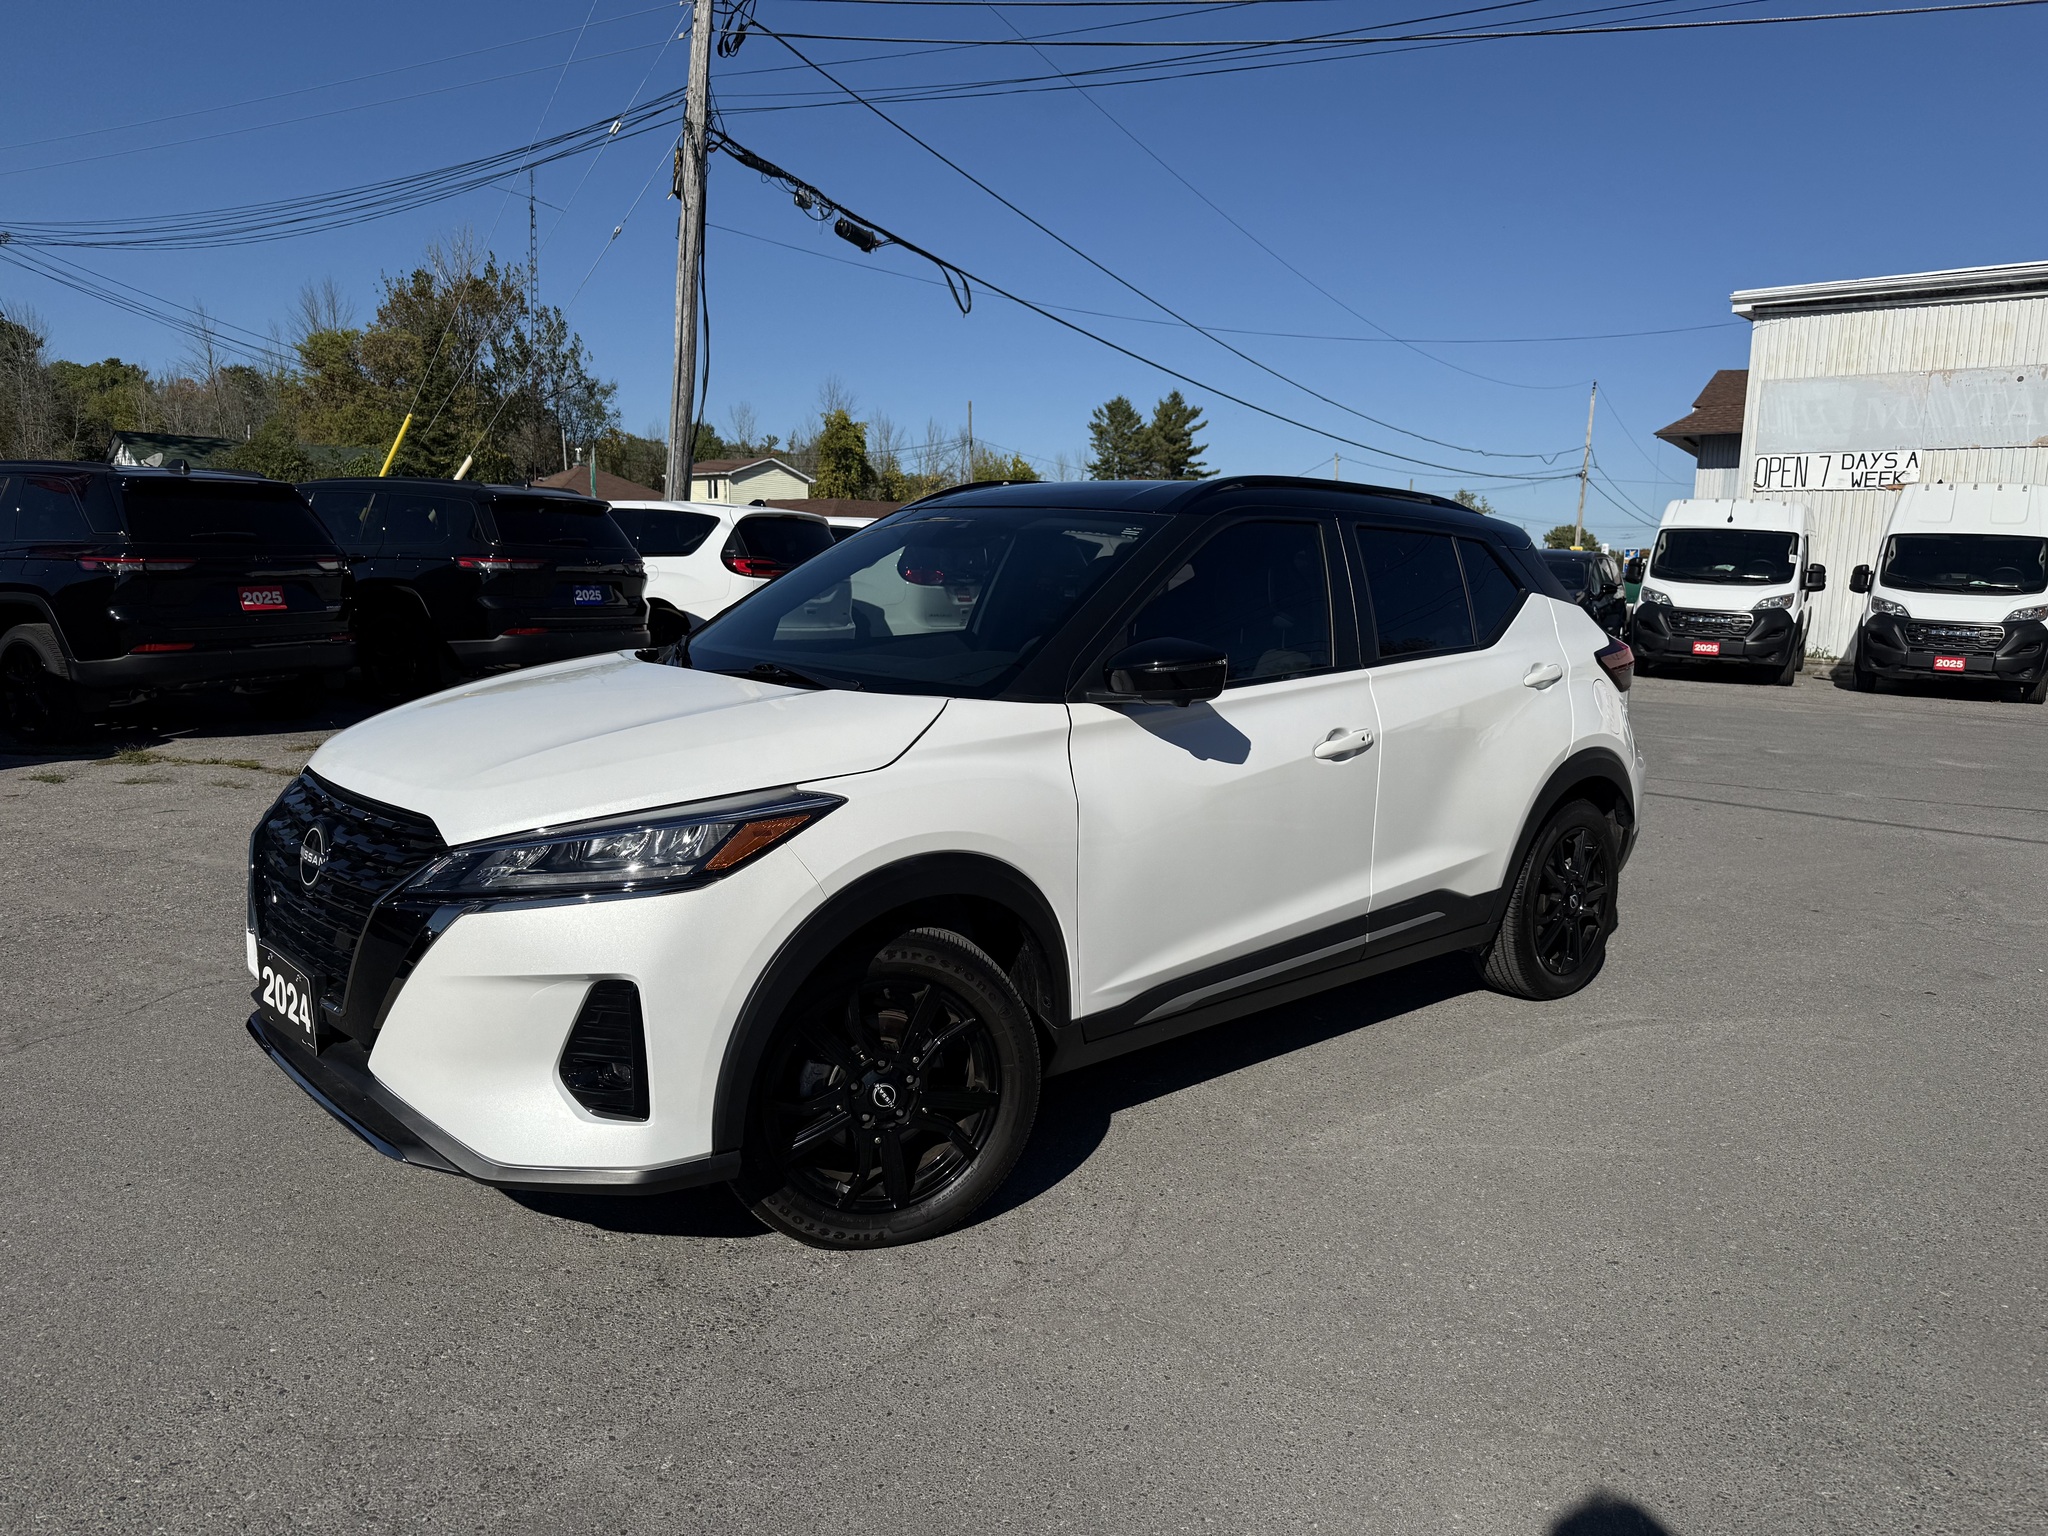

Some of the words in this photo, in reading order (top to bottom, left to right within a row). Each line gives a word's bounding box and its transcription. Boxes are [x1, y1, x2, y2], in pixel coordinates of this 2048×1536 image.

[1754, 456, 1809, 488] OPEN
[1819, 455, 1831, 487] 7
[1841, 452, 1898, 470] DAYS
[1906, 451, 1918, 469] A
[1851, 471, 1906, 488] WEEK
[242, 591, 282, 605] 2025
[575, 589, 602, 601] 2025
[1694, 643, 1719, 653] 2025
[1936, 658, 1964, 669] 2025
[300, 846, 329, 867] SSAN
[883, 948, 998, 1004] Firestone
[262, 965, 311, 1034] 2024
[766, 1196, 888, 1243] Firestone
